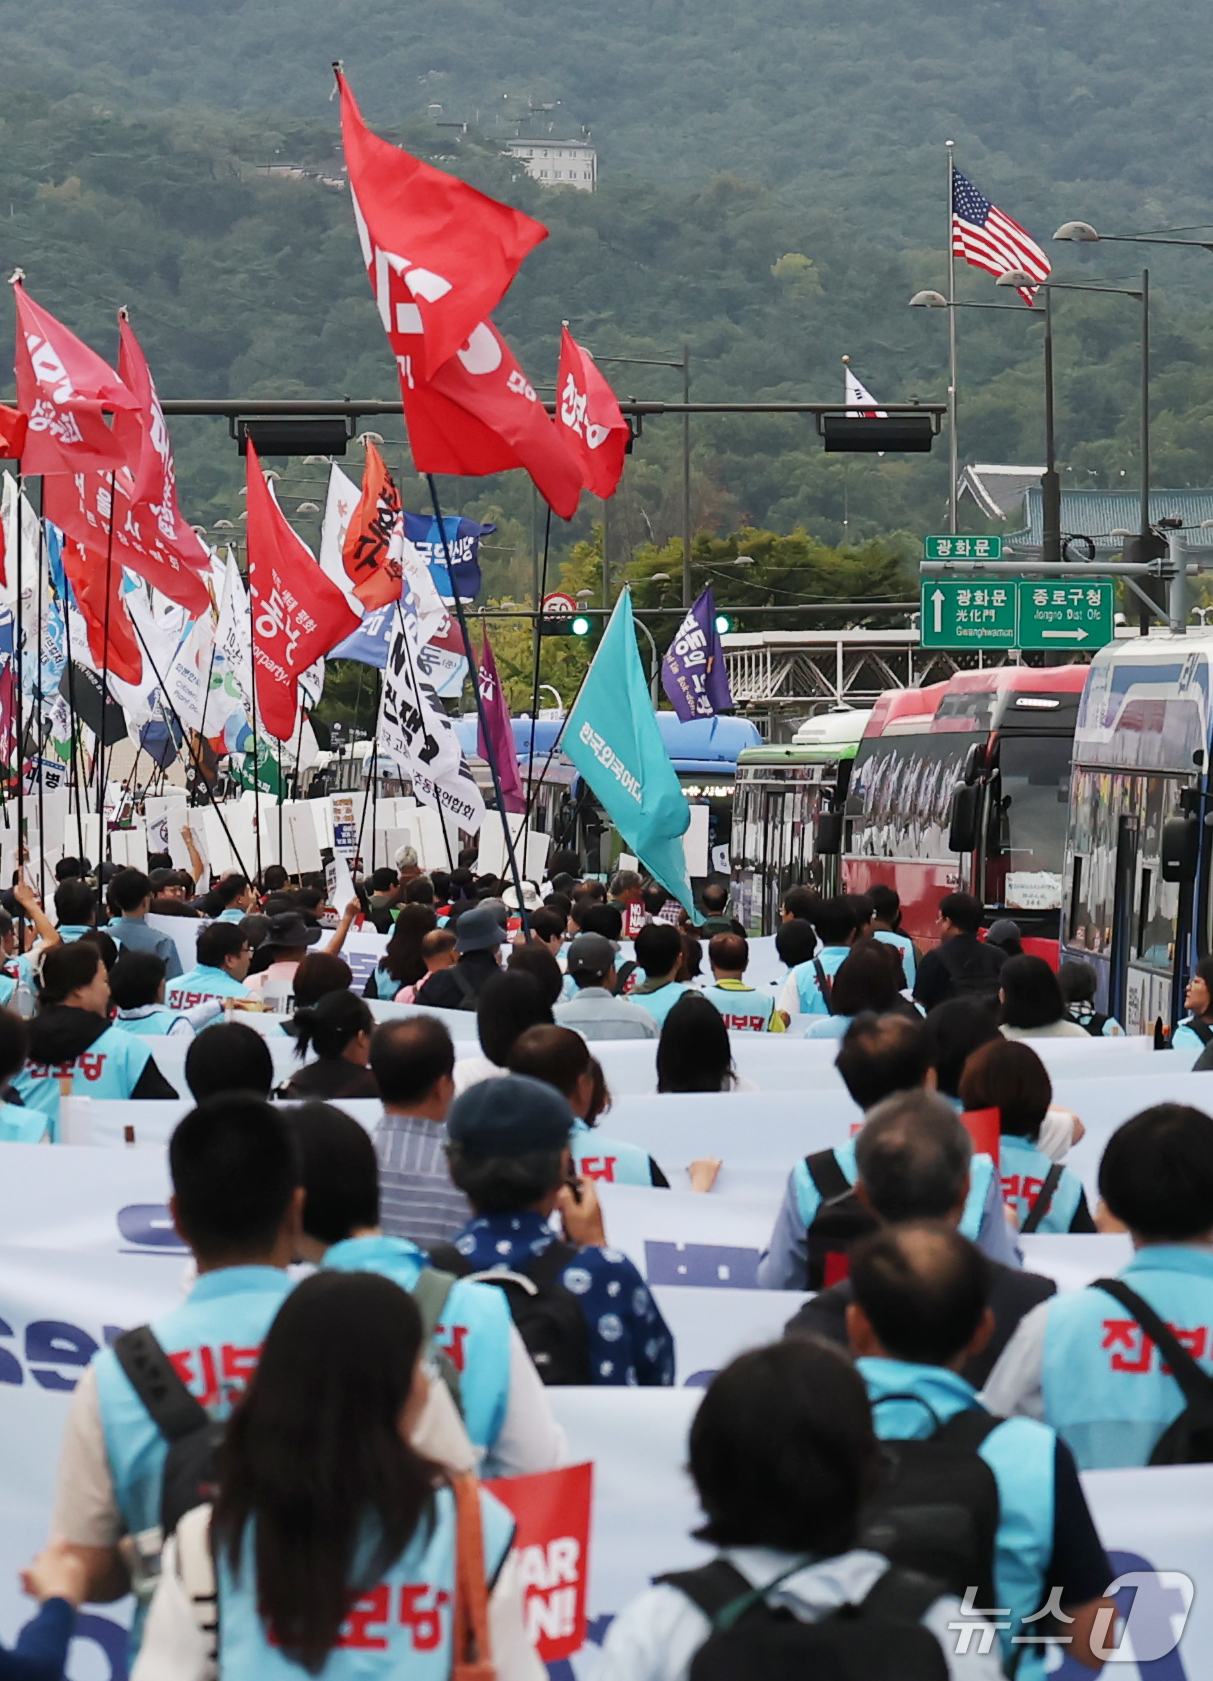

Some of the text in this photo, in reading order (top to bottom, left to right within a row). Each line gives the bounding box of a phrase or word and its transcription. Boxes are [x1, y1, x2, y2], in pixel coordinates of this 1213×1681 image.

[936, 538, 991, 557] 광화문
[956, 588, 1009, 607] 광화문
[1032, 588, 1102, 606] 종로구청
[295, 609, 317, 634] 평화
[956, 608, 996, 623] 光化門
[955, 625, 1014, 639] Gwanghwamun
